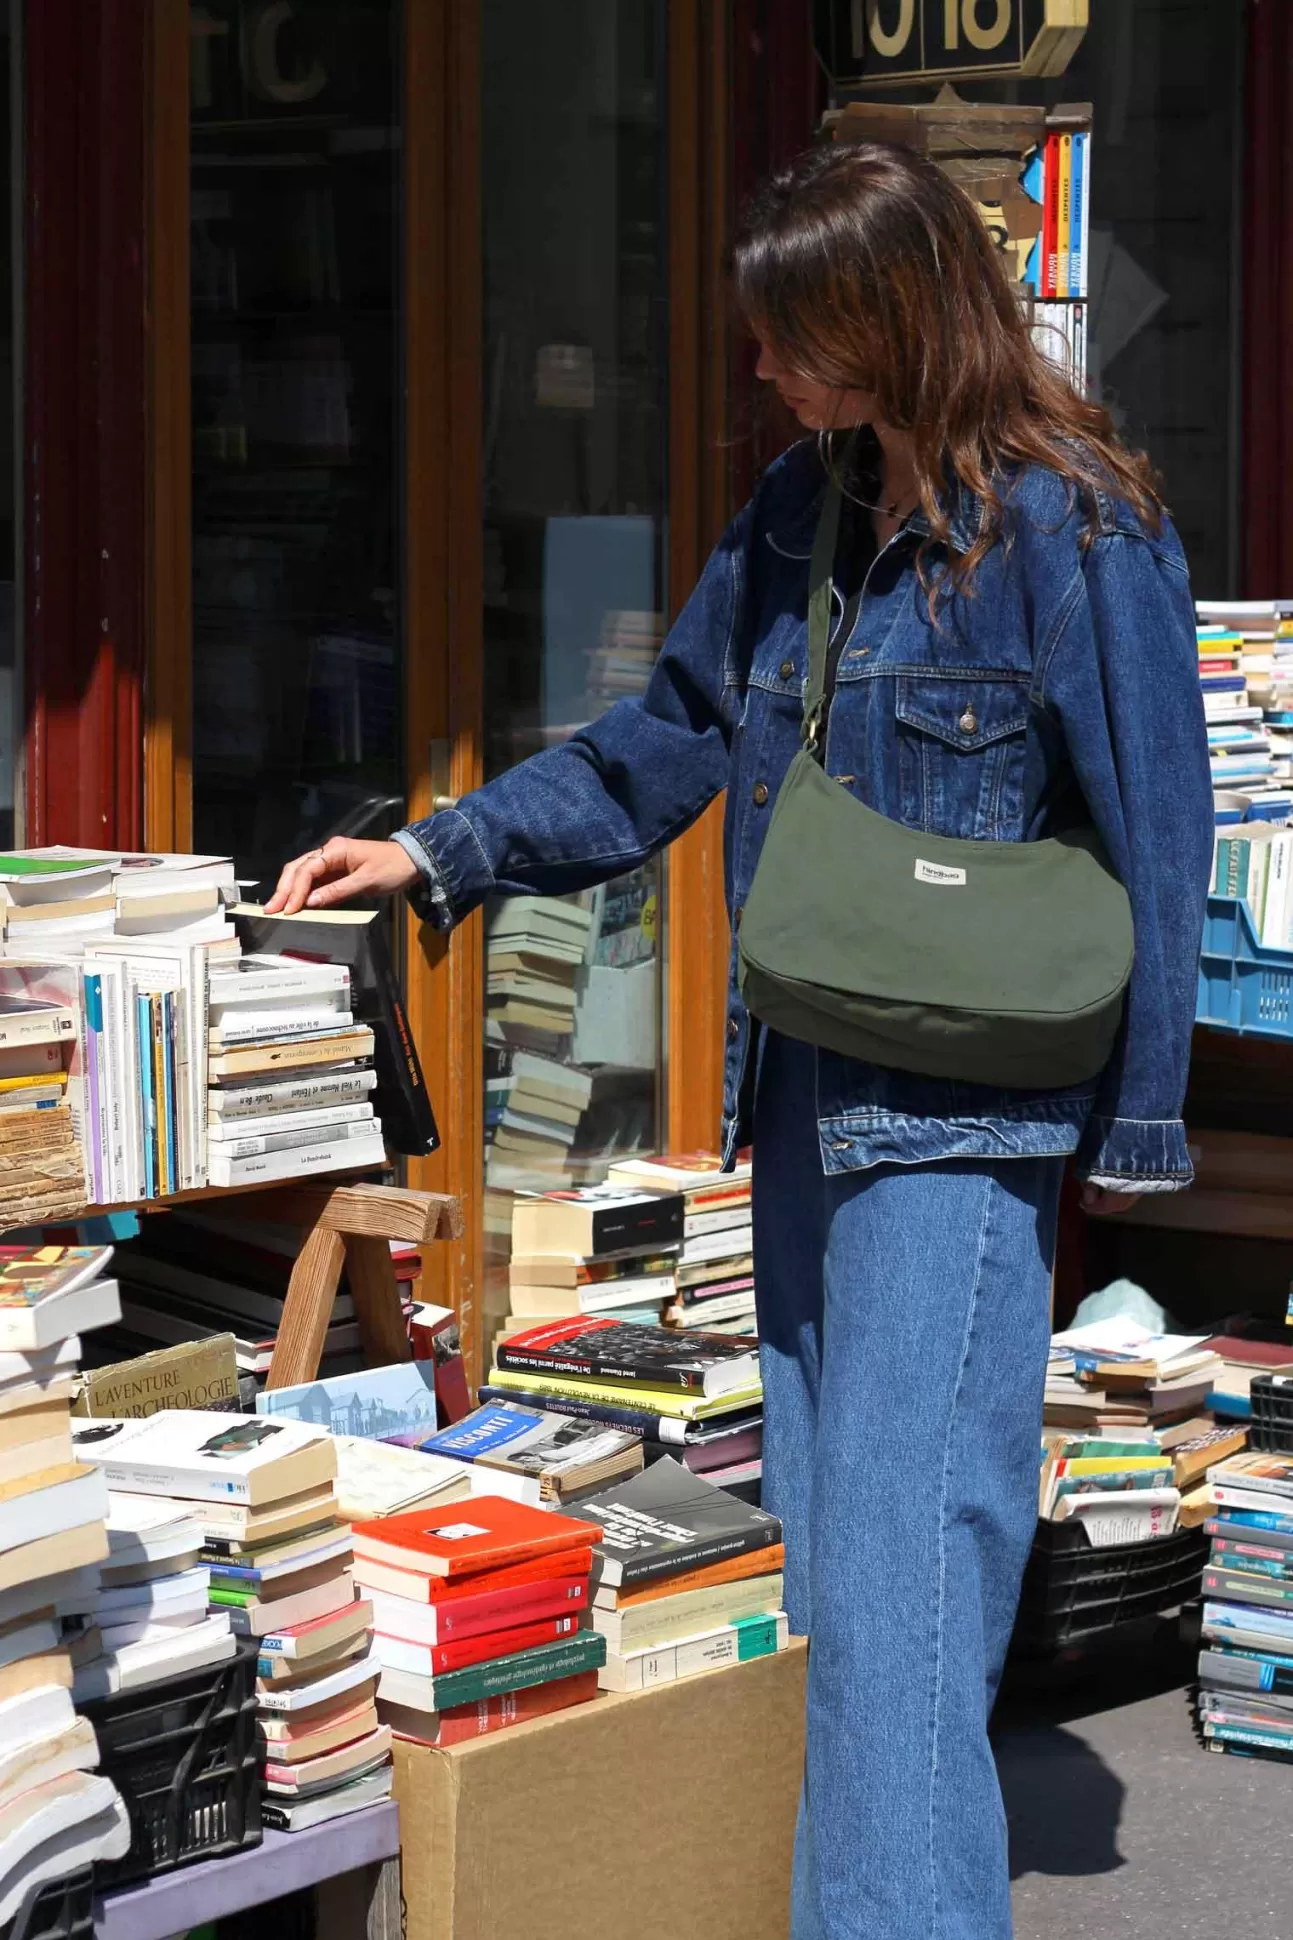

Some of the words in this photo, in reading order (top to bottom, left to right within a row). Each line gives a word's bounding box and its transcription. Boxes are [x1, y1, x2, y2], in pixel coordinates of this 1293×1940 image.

[529, 1358, 537, 1367] les
[583, 1366, 591, 1374] De
[600, 1367, 621, 1377] Diamond
[622, 1368, 636, 1378] Jared
[95, 1369, 181, 1407] L'AVENTURE
[601, 1394, 609, 1402] DE
[610, 1396, 647, 1409] CENTENAIRE
[441, 1416, 515, 1449] VISCONTI
